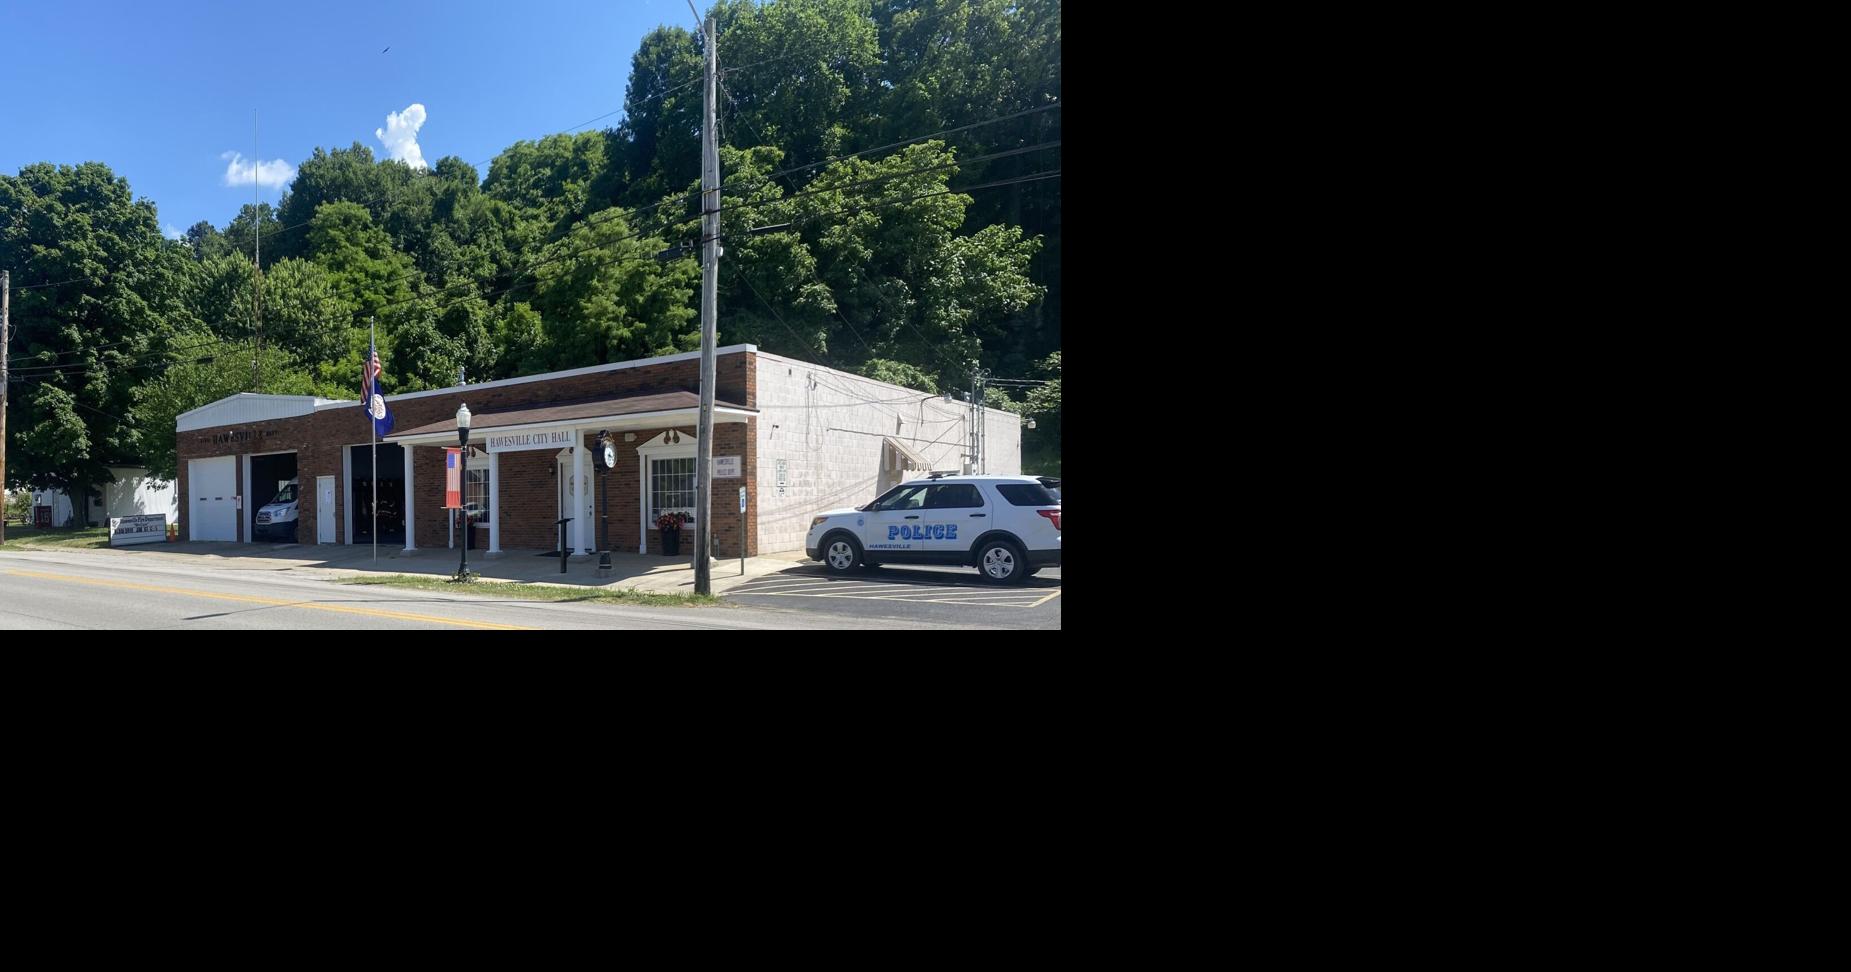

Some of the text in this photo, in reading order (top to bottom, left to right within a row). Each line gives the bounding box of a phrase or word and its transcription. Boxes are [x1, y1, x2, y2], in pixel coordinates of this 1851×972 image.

[490, 431, 571, 448] HAWESVILLE CITY HALL
[887, 523, 958, 541] POLICE
